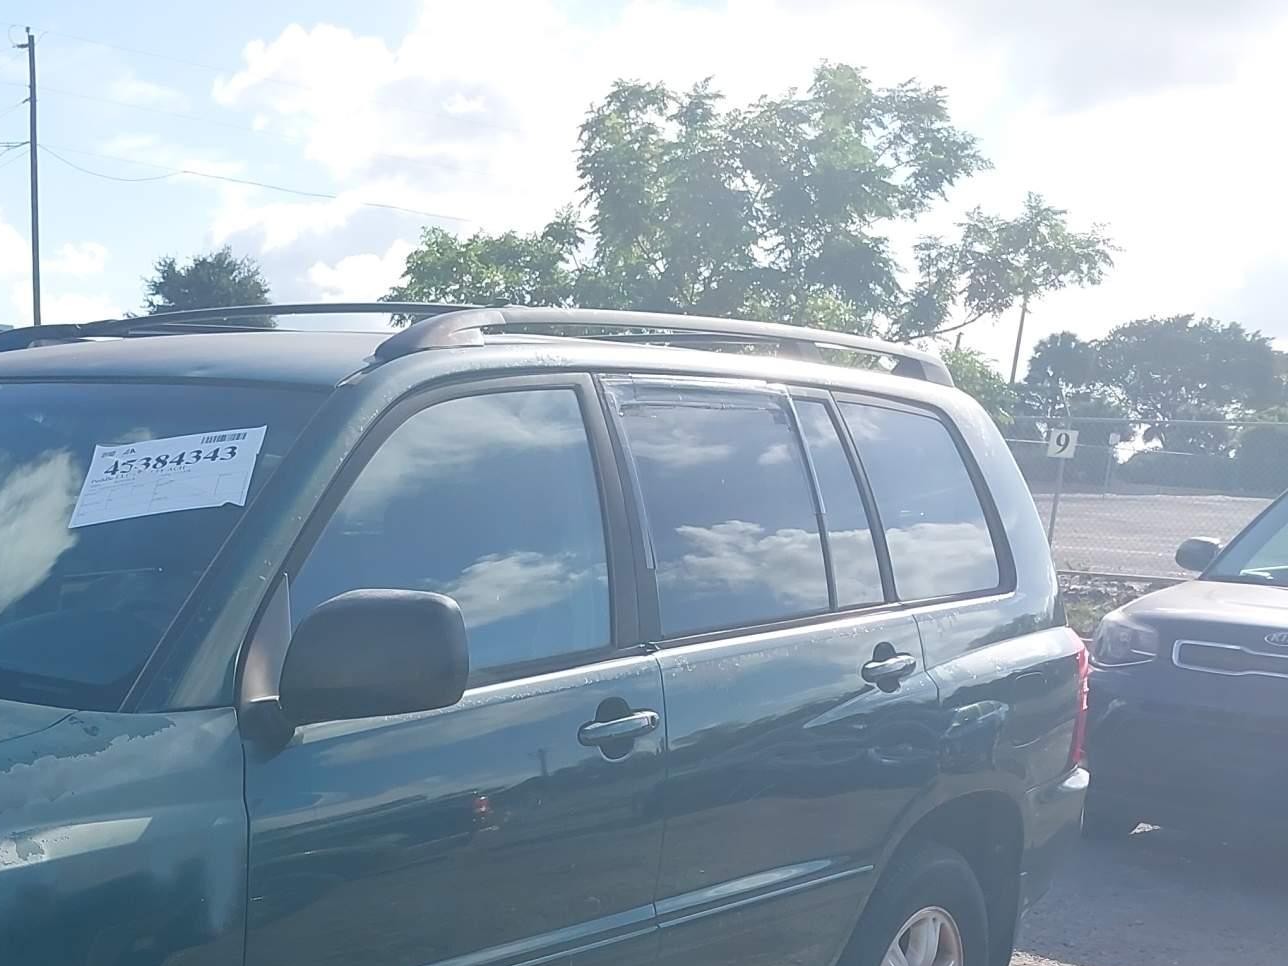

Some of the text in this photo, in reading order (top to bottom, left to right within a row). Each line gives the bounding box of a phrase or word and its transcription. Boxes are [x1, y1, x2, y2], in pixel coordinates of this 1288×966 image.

[1055, 432, 1071, 455] 9
[103, 445, 238, 476] 45384343
[1269, 632, 1288, 643] KI
